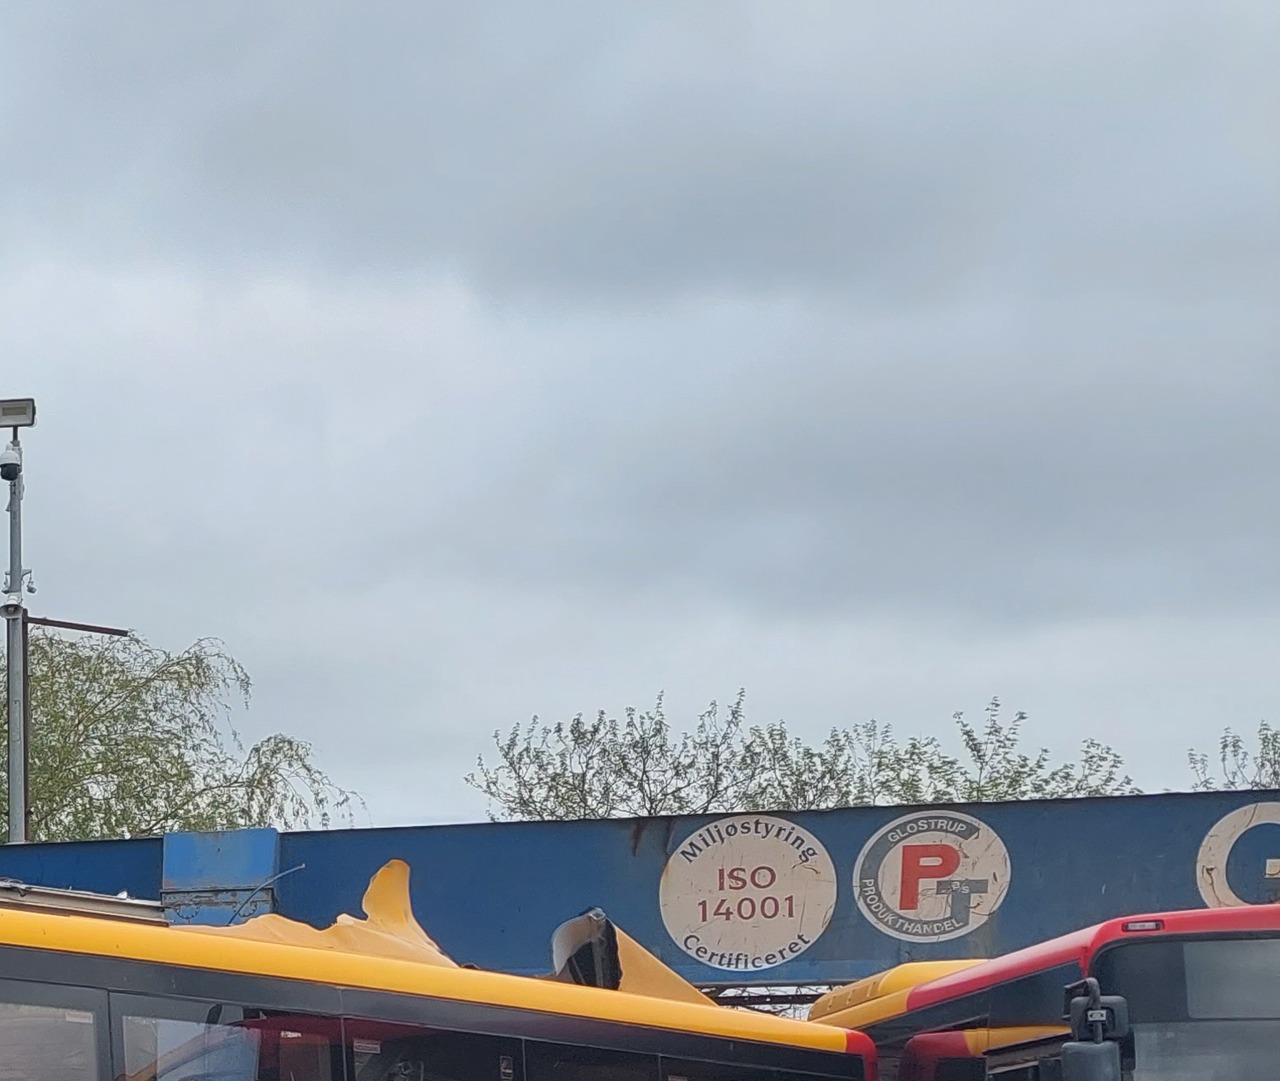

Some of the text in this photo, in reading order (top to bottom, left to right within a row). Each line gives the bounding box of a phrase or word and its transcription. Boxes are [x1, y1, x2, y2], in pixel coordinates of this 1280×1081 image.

[680, 818, 818, 864] Miljøstyring
[888, 819, 967, 843] GLOSTRUP
[717, 866, 777, 891] ISO
[697, 895, 795, 923] 14001
[862, 878, 964, 934] PRODUKTHANDEL
[683, 932, 811, 970] Certificeret
